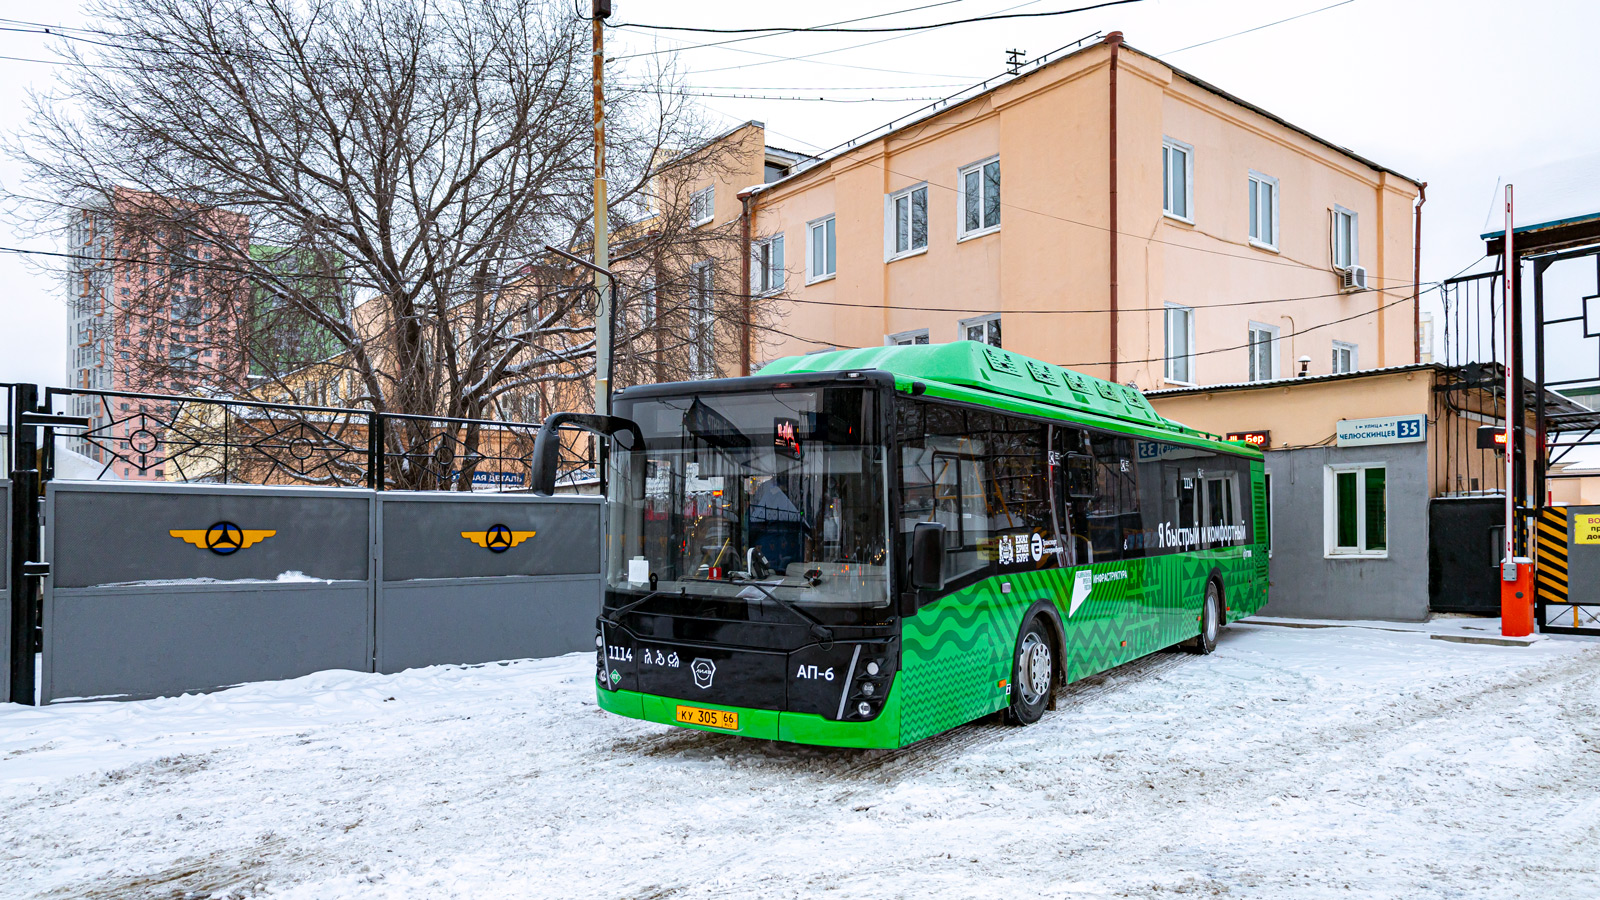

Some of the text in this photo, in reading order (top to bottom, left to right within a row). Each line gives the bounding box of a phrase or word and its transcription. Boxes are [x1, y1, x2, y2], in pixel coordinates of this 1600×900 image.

[1340, 430, 1396, 440] ЧЕЛЮСКИНЦЕВ
[1400, 422, 1418, 436] 35
[1183, 477, 1193, 489] 1114
[1158, 519, 1246, 551] Я быстрый и комфортный
[1093, 570, 1127, 583] ИНФРАСТРУКТУРА
[609, 645, 633, 662] 1114
[796, 664, 835, 681] АП-6
[698, 710, 717, 724] 305
[723, 713, 733, 723] 66
